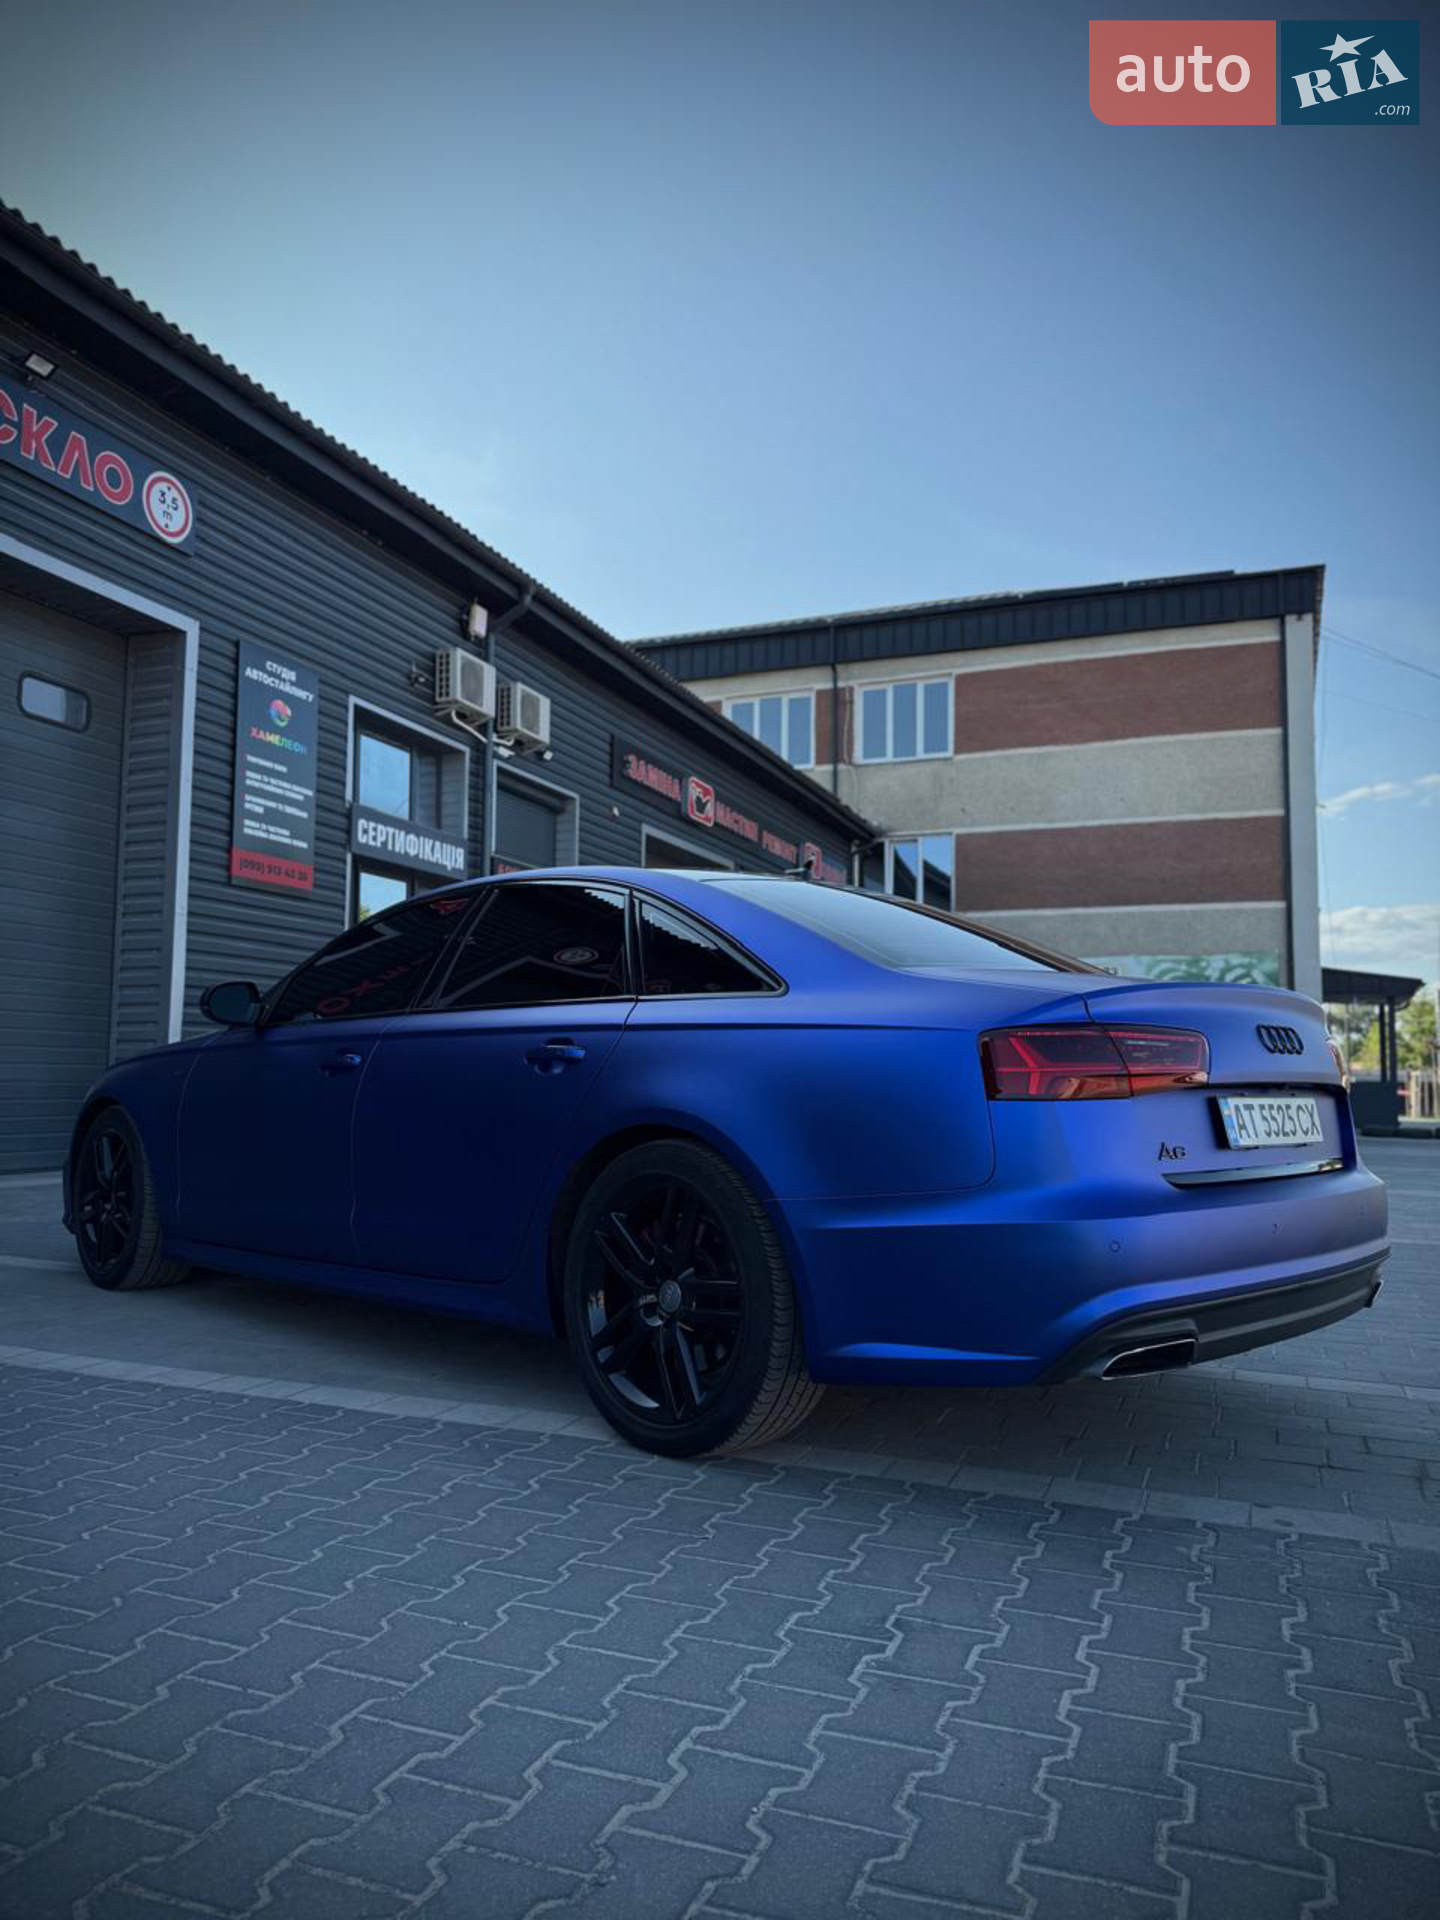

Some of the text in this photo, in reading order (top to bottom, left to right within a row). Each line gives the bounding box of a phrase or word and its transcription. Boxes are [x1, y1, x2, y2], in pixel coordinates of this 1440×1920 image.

[250, 727, 307, 756] ХАМЕЛЕОН
[357, 818, 465, 871] СЕРТИФІКАЦІЯ
[1233, 1103, 1321, 1138] AT 5525 CX
[1158, 1142, 1186, 1161] A6
